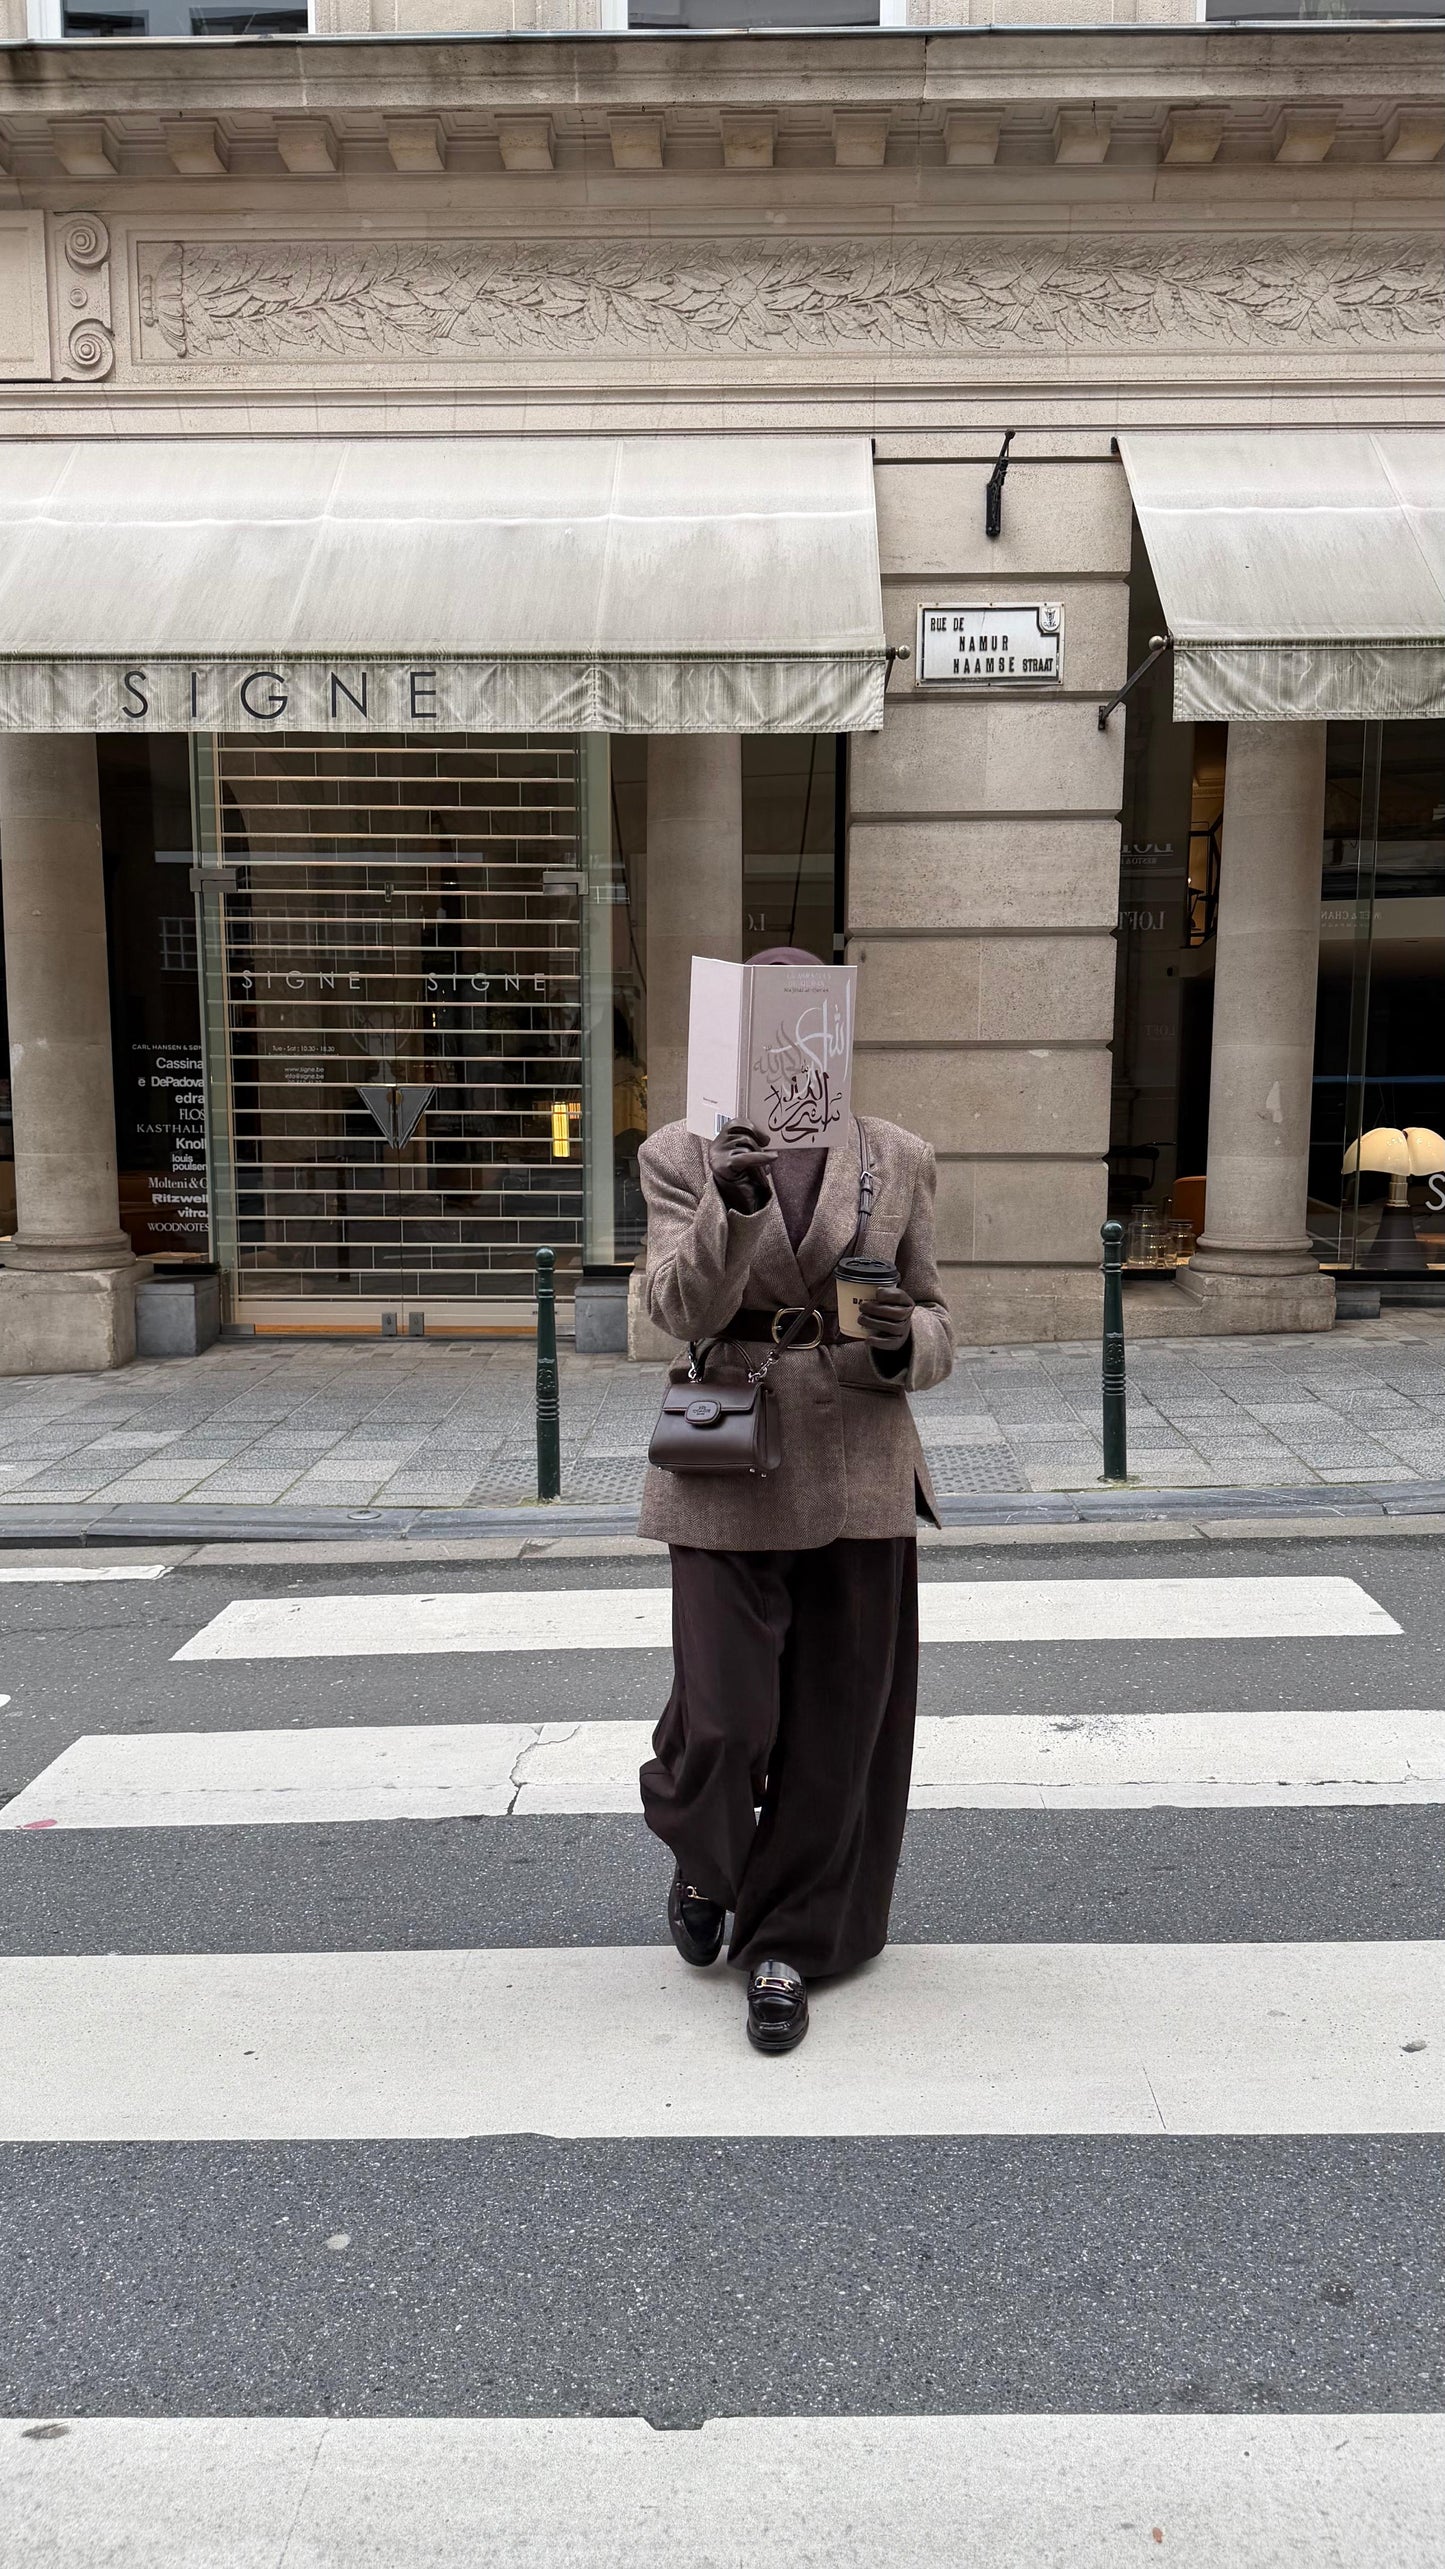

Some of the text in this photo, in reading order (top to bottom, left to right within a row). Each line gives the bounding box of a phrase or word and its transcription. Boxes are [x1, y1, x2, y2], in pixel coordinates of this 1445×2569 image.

[929, 617, 965, 632] RUE DE
[959, 635, 1009, 652] NAMUR
[953, 656, 1054, 674] NAAMSE STRAAT
[122, 670, 437, 720] SIGNE
[242, 970, 545, 991] SIGNE SIGNE
[156, 1057, 203, 1069] Cassina
[151, 1076, 205, 1087] DePadova
[175, 1092, 205, 1104] edra
[179, 1108, 206, 1121] FLOS
[176, 1138, 207, 1150] Knoll
[172, 1154, 194, 1163] louis
[172, 1162, 208, 1172] poulsen
[147, 1222, 209, 1232] WOODNOTES
